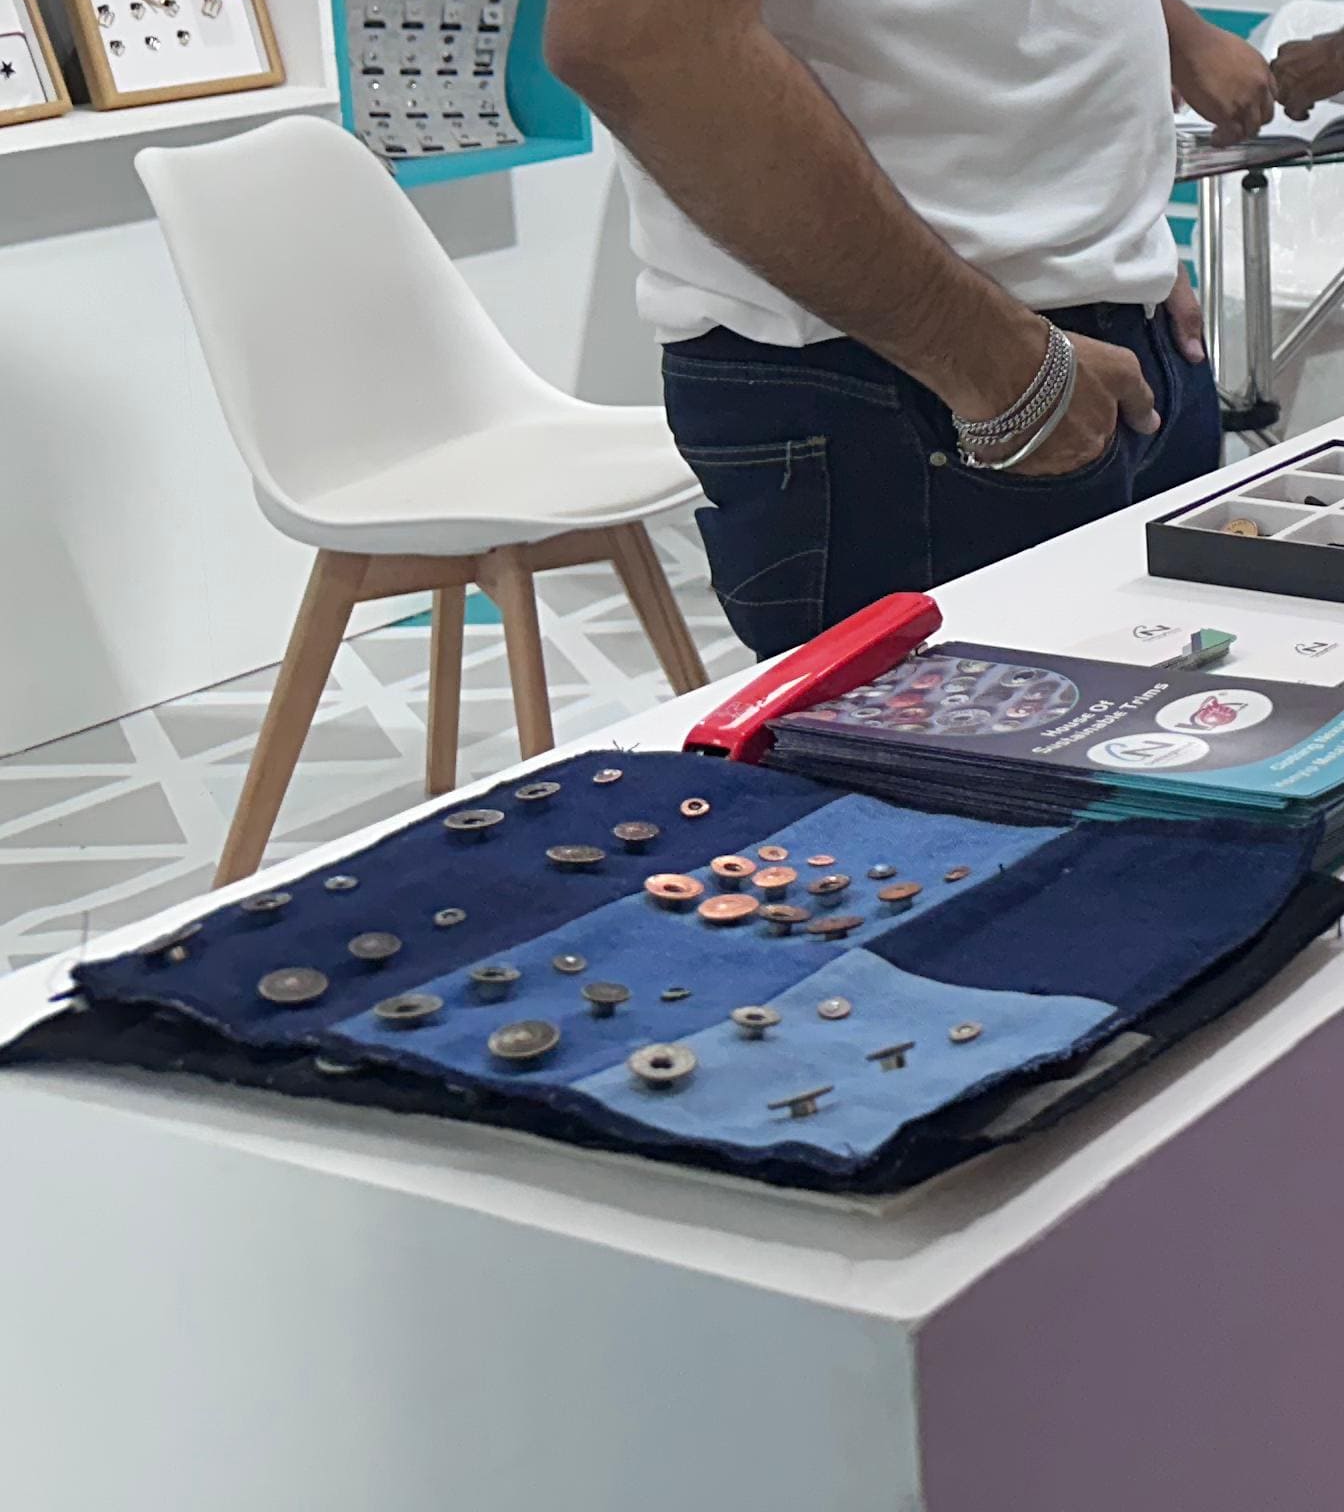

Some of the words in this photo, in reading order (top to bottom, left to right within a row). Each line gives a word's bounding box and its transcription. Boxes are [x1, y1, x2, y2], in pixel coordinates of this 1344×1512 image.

[1032, 711, 1128, 754] Sustainable
[1119, 683, 1169, 709] Trims
[1041, 712, 1096, 737] House
[1089, 699, 1115, 712] Of
